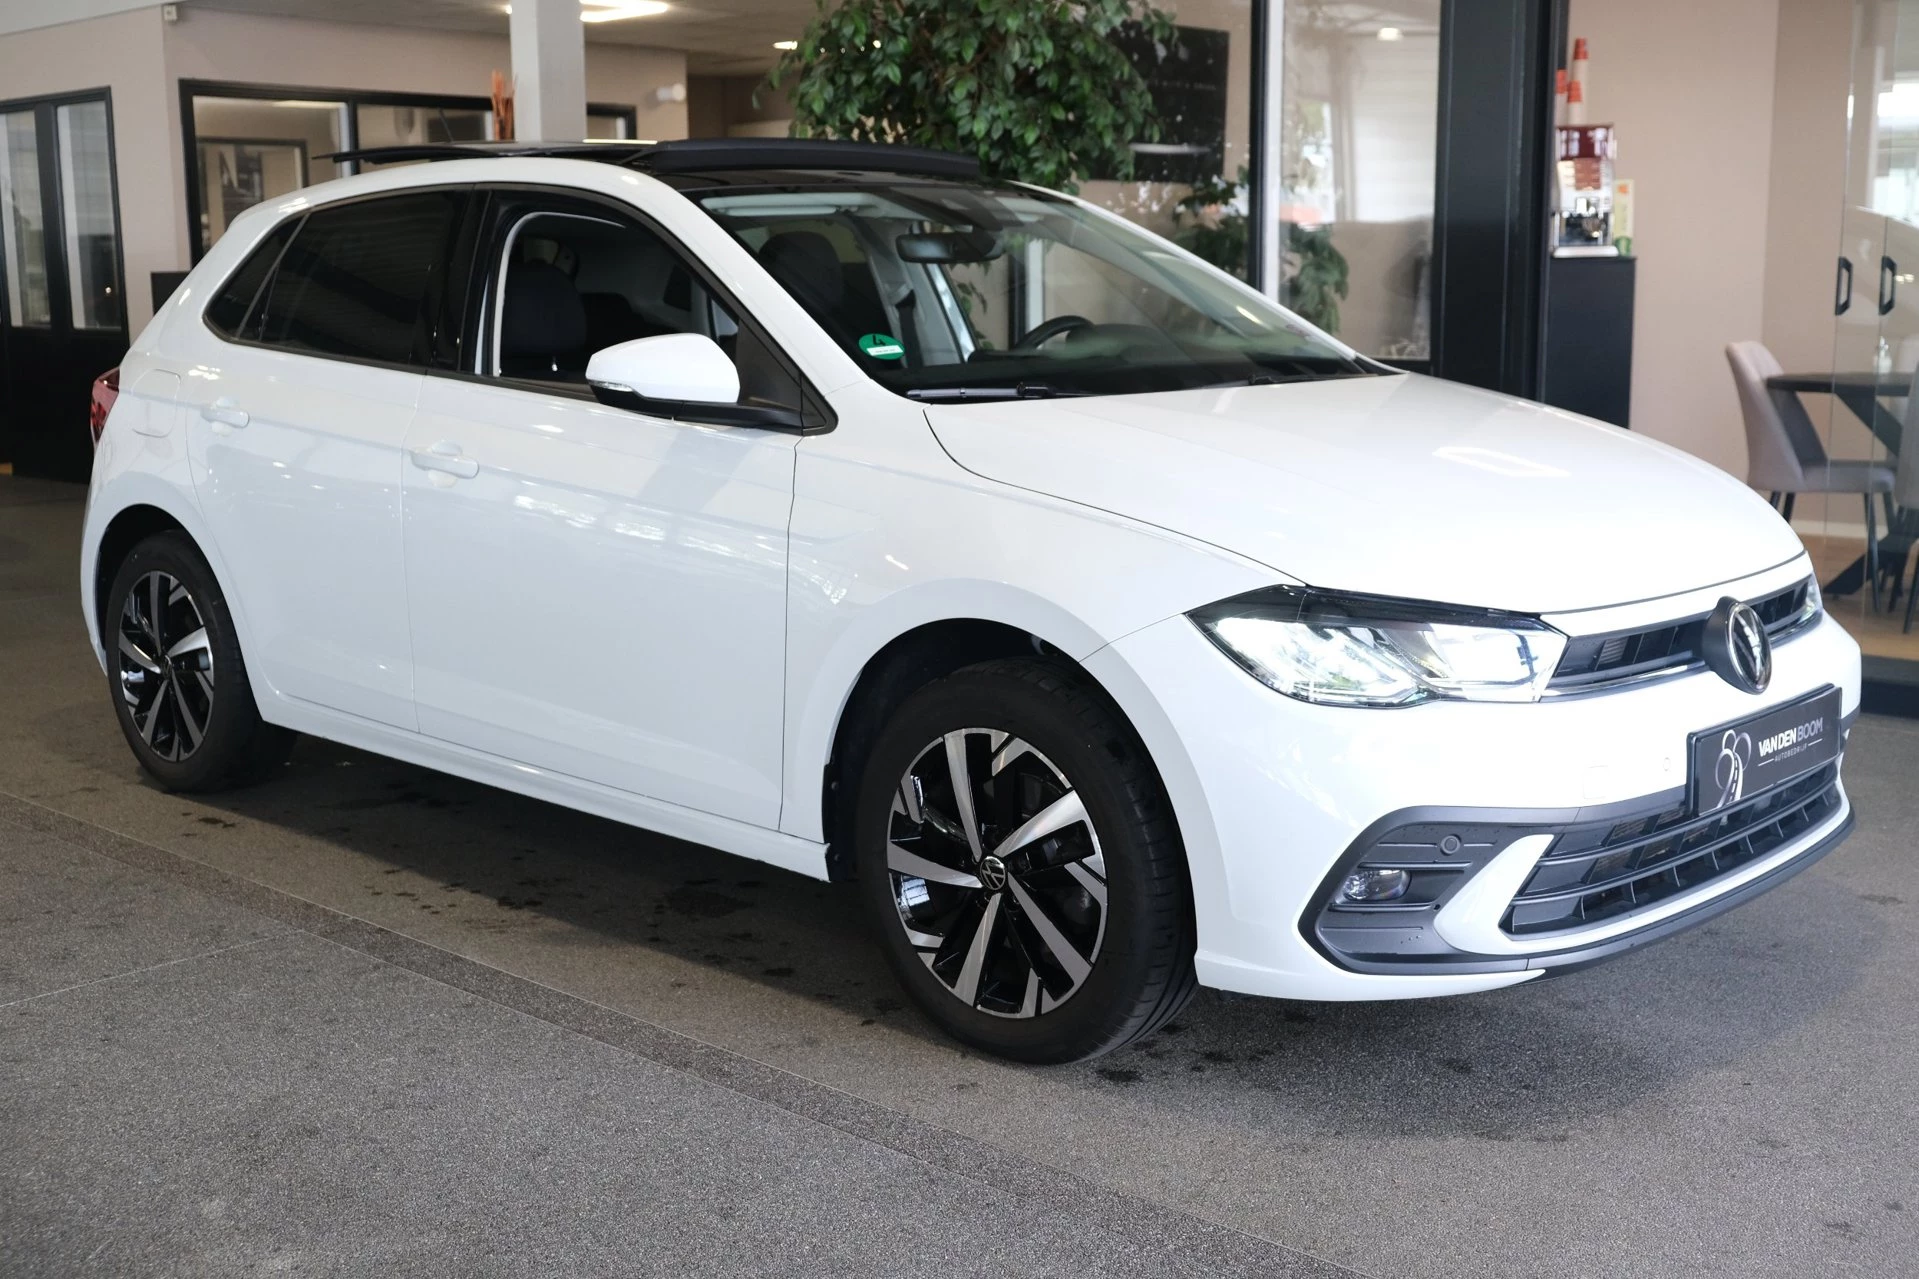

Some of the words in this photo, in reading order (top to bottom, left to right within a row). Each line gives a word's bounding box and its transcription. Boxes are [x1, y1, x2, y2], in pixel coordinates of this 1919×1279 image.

[1758, 735, 1778, 757] VAN
[1777, 727, 1797, 750] DEN
[1797, 717, 1823, 742] BOOM
